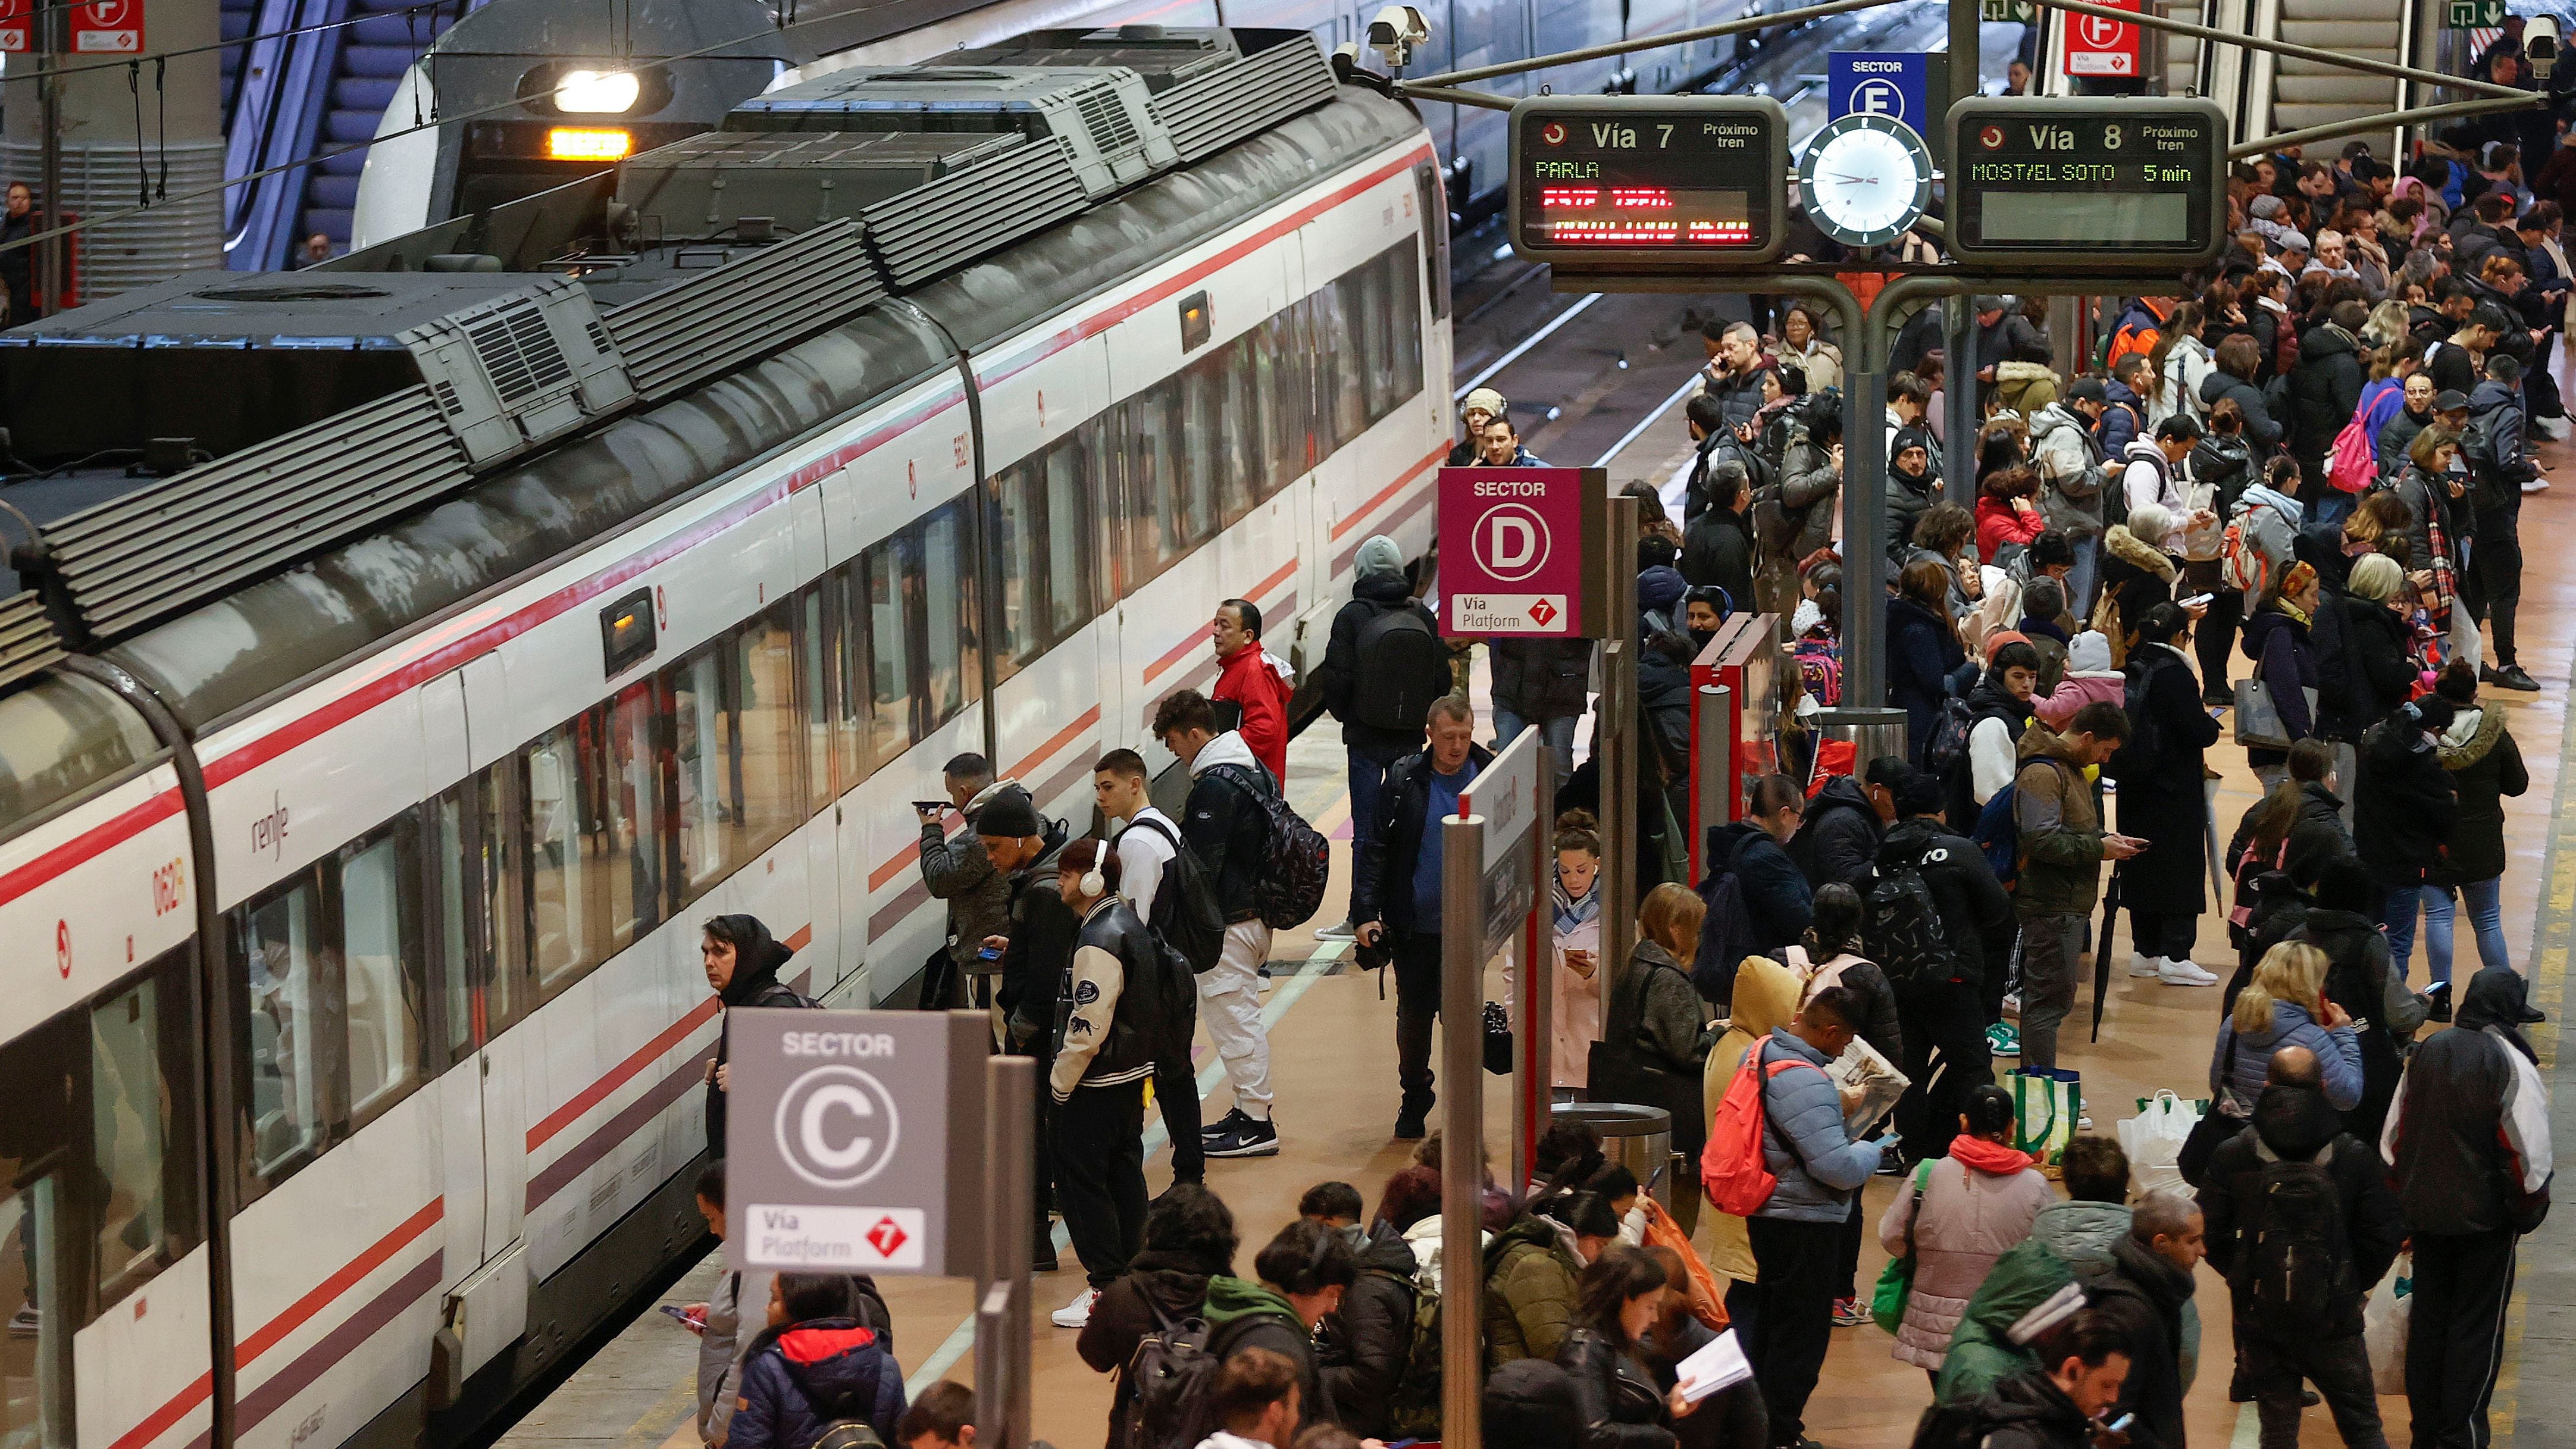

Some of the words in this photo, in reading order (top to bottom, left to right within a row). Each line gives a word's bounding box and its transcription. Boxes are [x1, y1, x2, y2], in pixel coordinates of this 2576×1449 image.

[1852, 61, 1902, 73] SECTOR
[1591, 123, 1636, 148] Vía
[1657, 124, 1674, 148] 7
[1703, 123, 1758, 135] Próximo
[2029, 125, 2074, 150] Vía
[2104, 124, 2121, 149] 8
[2142, 126, 2198, 138] Próximo
[1717, 137, 1745, 148] tren
[2157, 140, 2184, 151] tren
[1535, 162, 1600, 178] PARLA
[1972, 164, 2057, 181] MOST/EL
[2062, 164, 2115, 181] SOTO
[2143, 165, 2157, 181] 5
[2162, 165, 2191, 181] min
[1474, 482, 1545, 496] SECTOR
[1492, 517, 1535, 567] D
[1464, 597, 1486, 610] Vía
[1536, 605, 1549, 620] 7
[1463, 614, 1520, 630] Platform
[252, 789, 288, 862] renfe
[782, 1031, 895, 1057] SECTOR
[800, 1084, 874, 1169] C
[763, 1210, 799, 1229] Vía
[877, 1224, 896, 1250] 7
[762, 1235, 852, 1263] Platform
